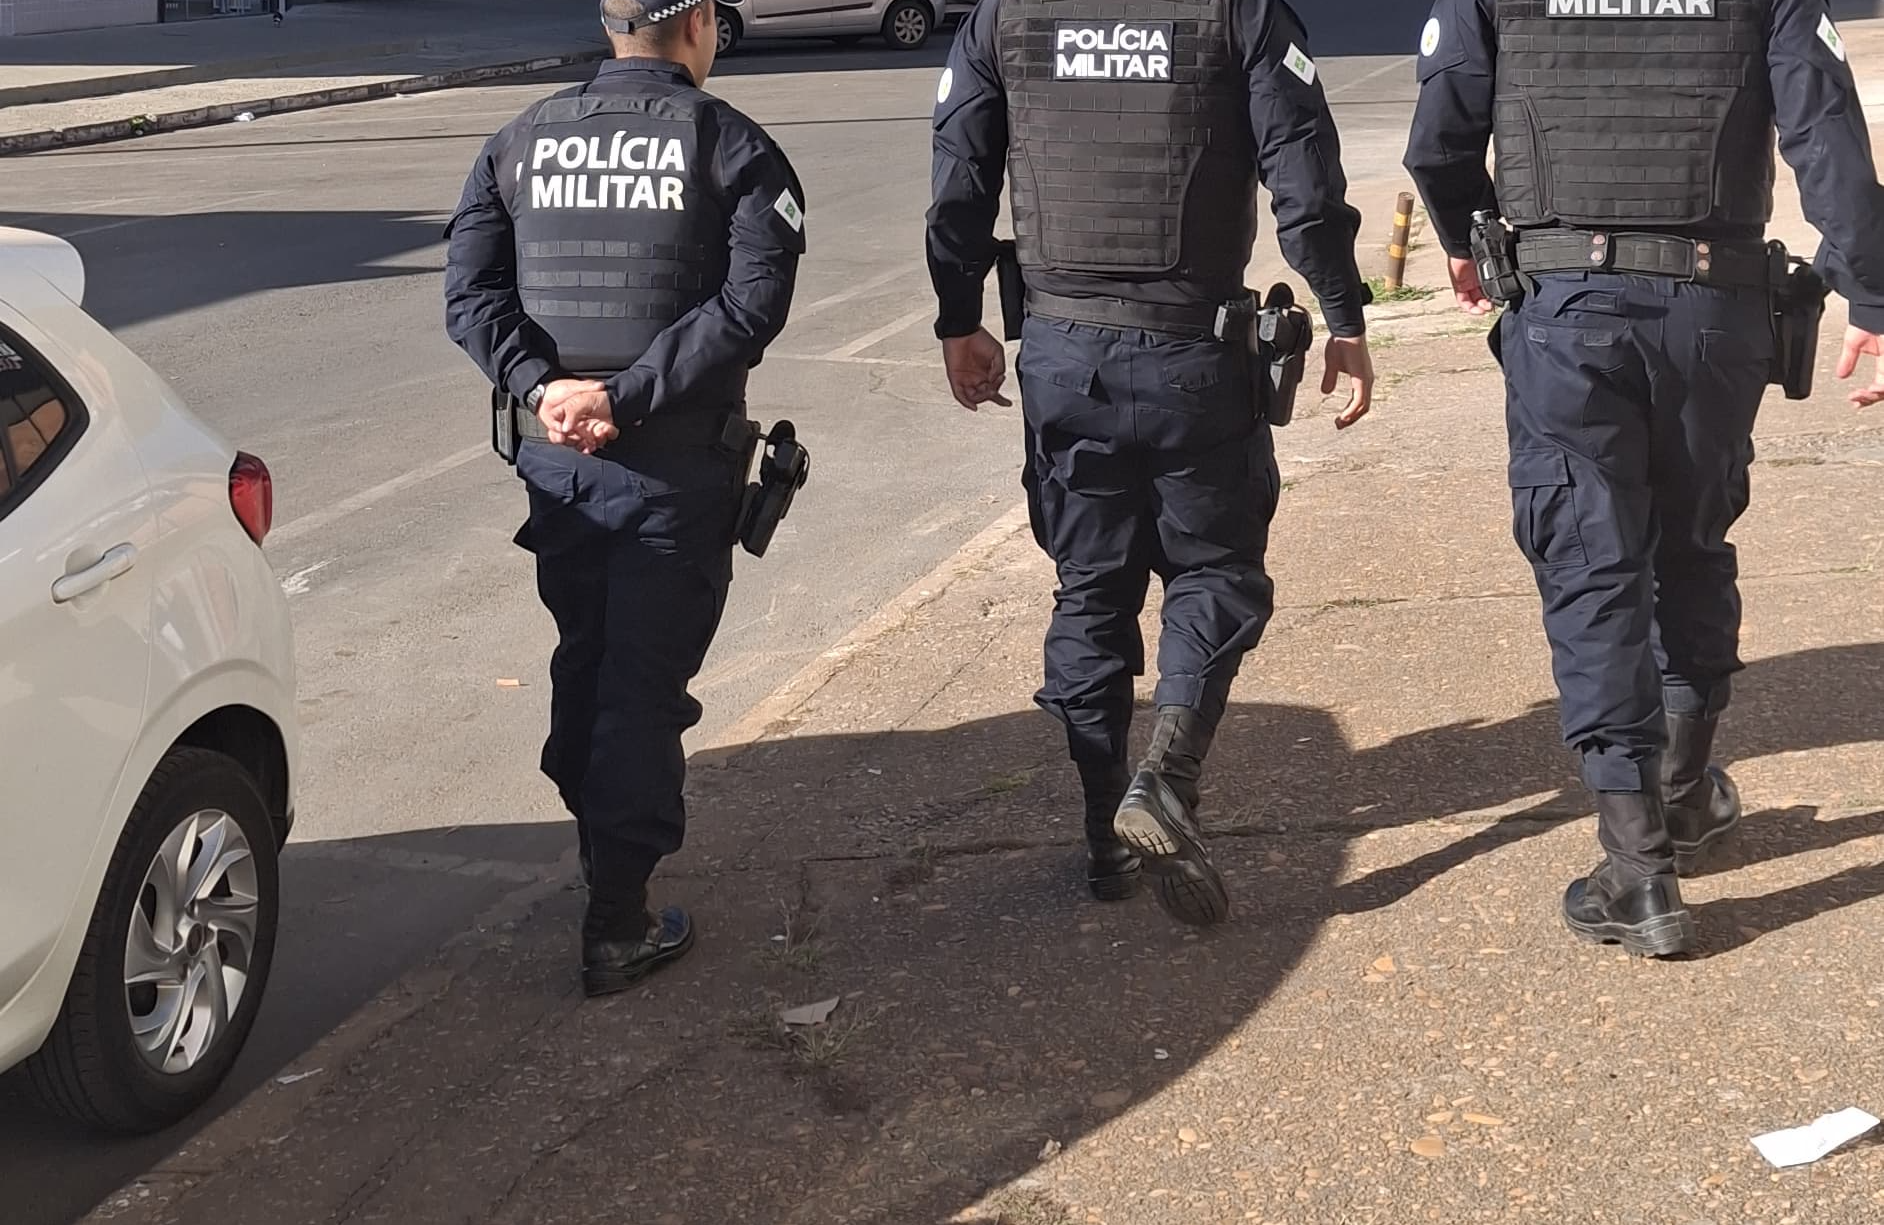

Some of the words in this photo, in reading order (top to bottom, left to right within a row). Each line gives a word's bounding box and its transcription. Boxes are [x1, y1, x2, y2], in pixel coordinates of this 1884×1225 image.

[1057, 23, 1168, 51] POLÍCIA
[1056, 53, 1169, 78] MILITAR
[532, 130, 685, 171] POLÍCIA
[531, 174, 685, 210] MILITAR
